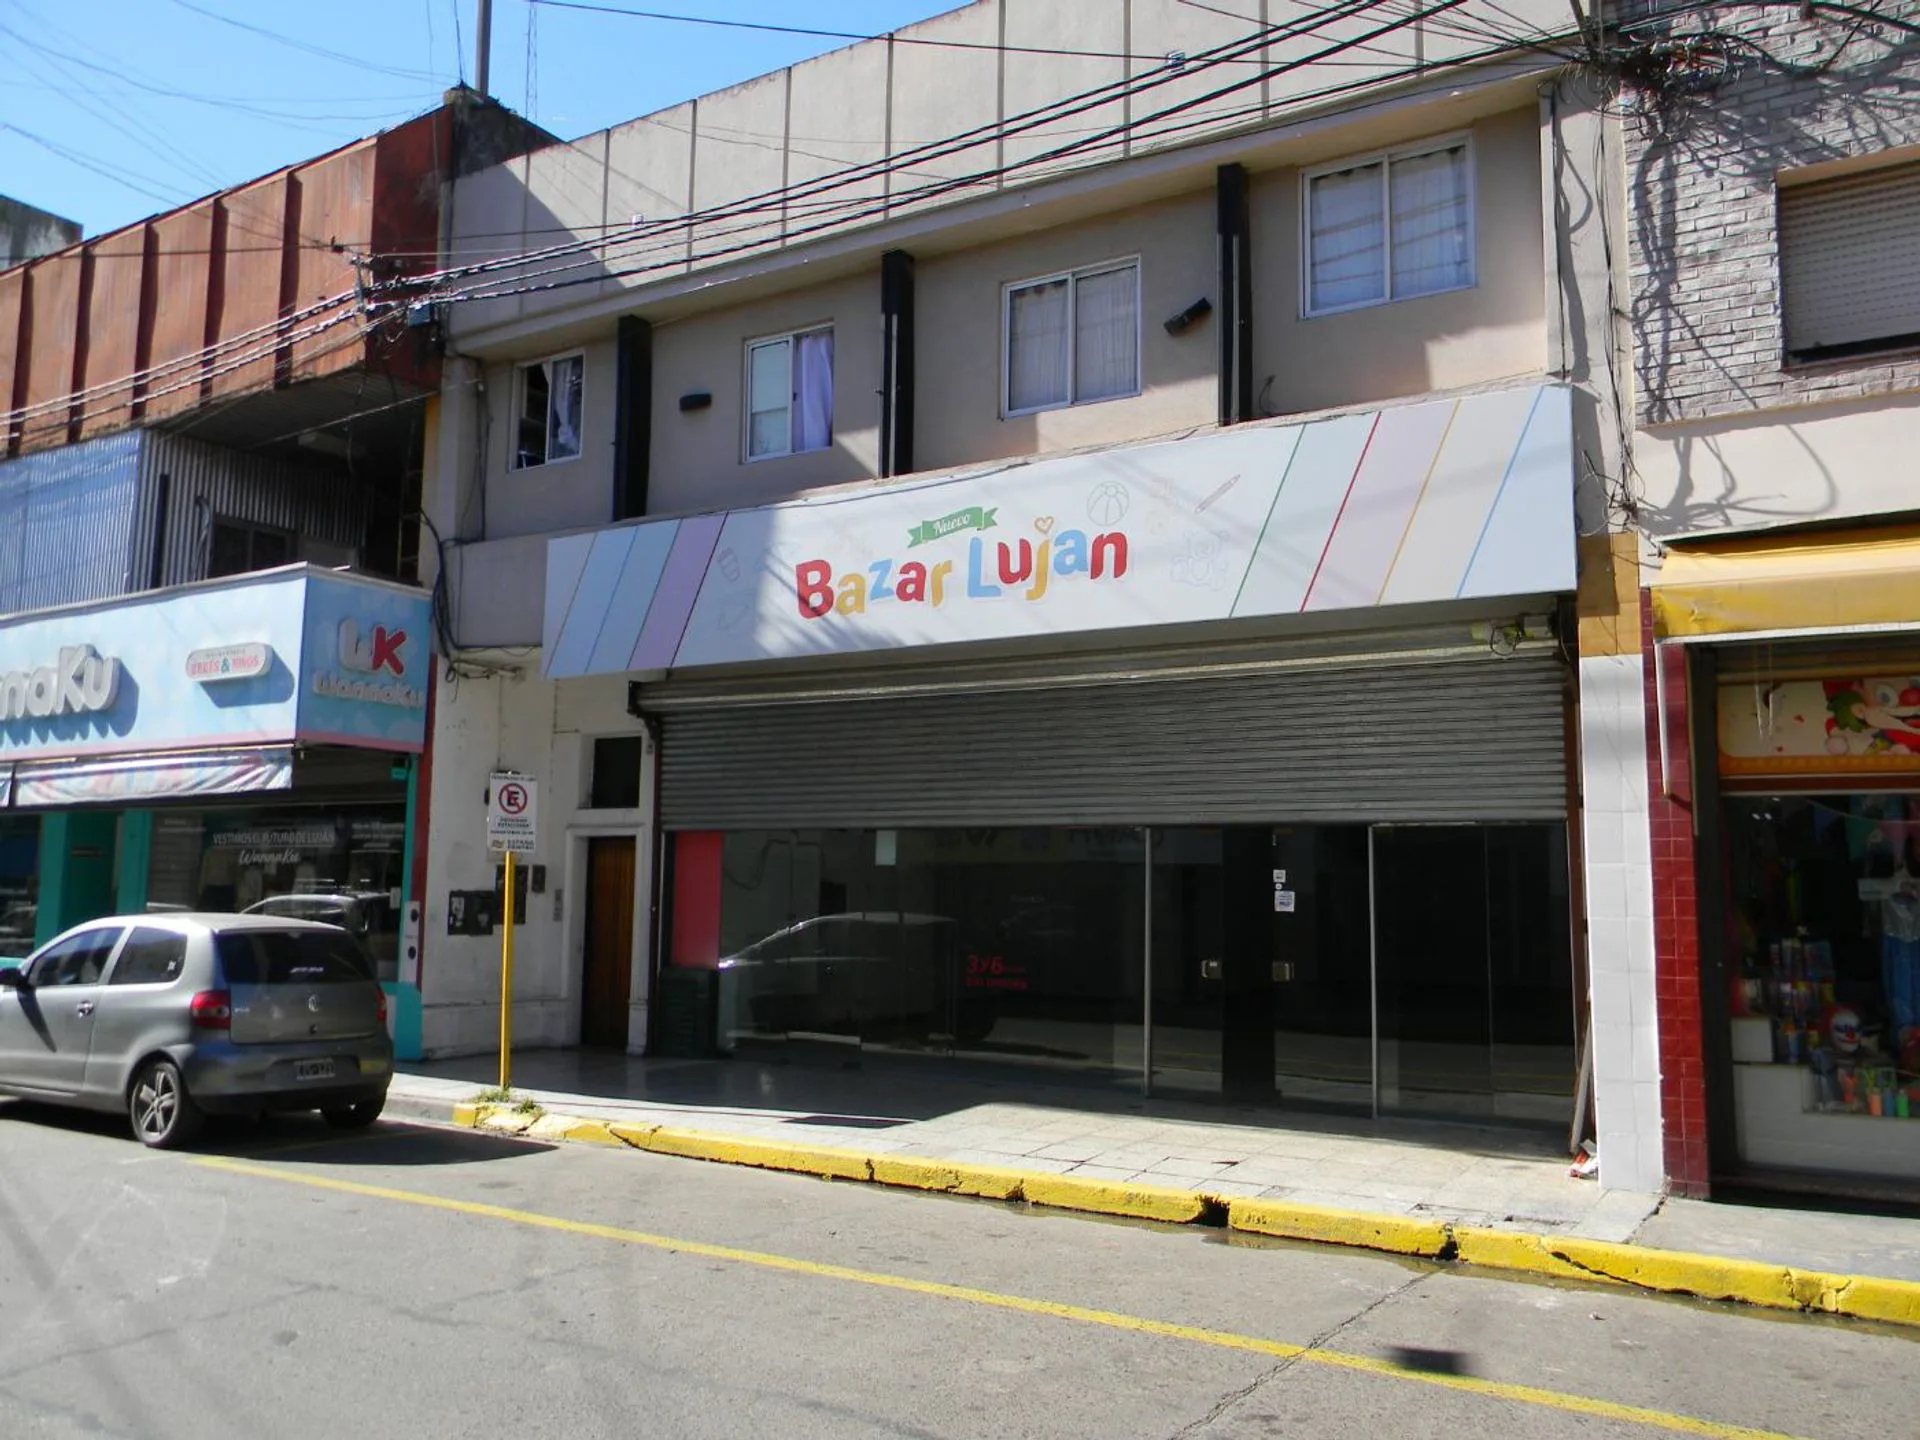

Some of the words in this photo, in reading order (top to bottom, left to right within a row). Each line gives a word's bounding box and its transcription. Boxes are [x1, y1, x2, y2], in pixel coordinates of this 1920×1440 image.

[935, 514, 970, 536] Nuevo
[796, 559, 952, 619] Bazar
[967, 516, 1128, 601] Lujan
[0, 643, 119, 719] naKu
